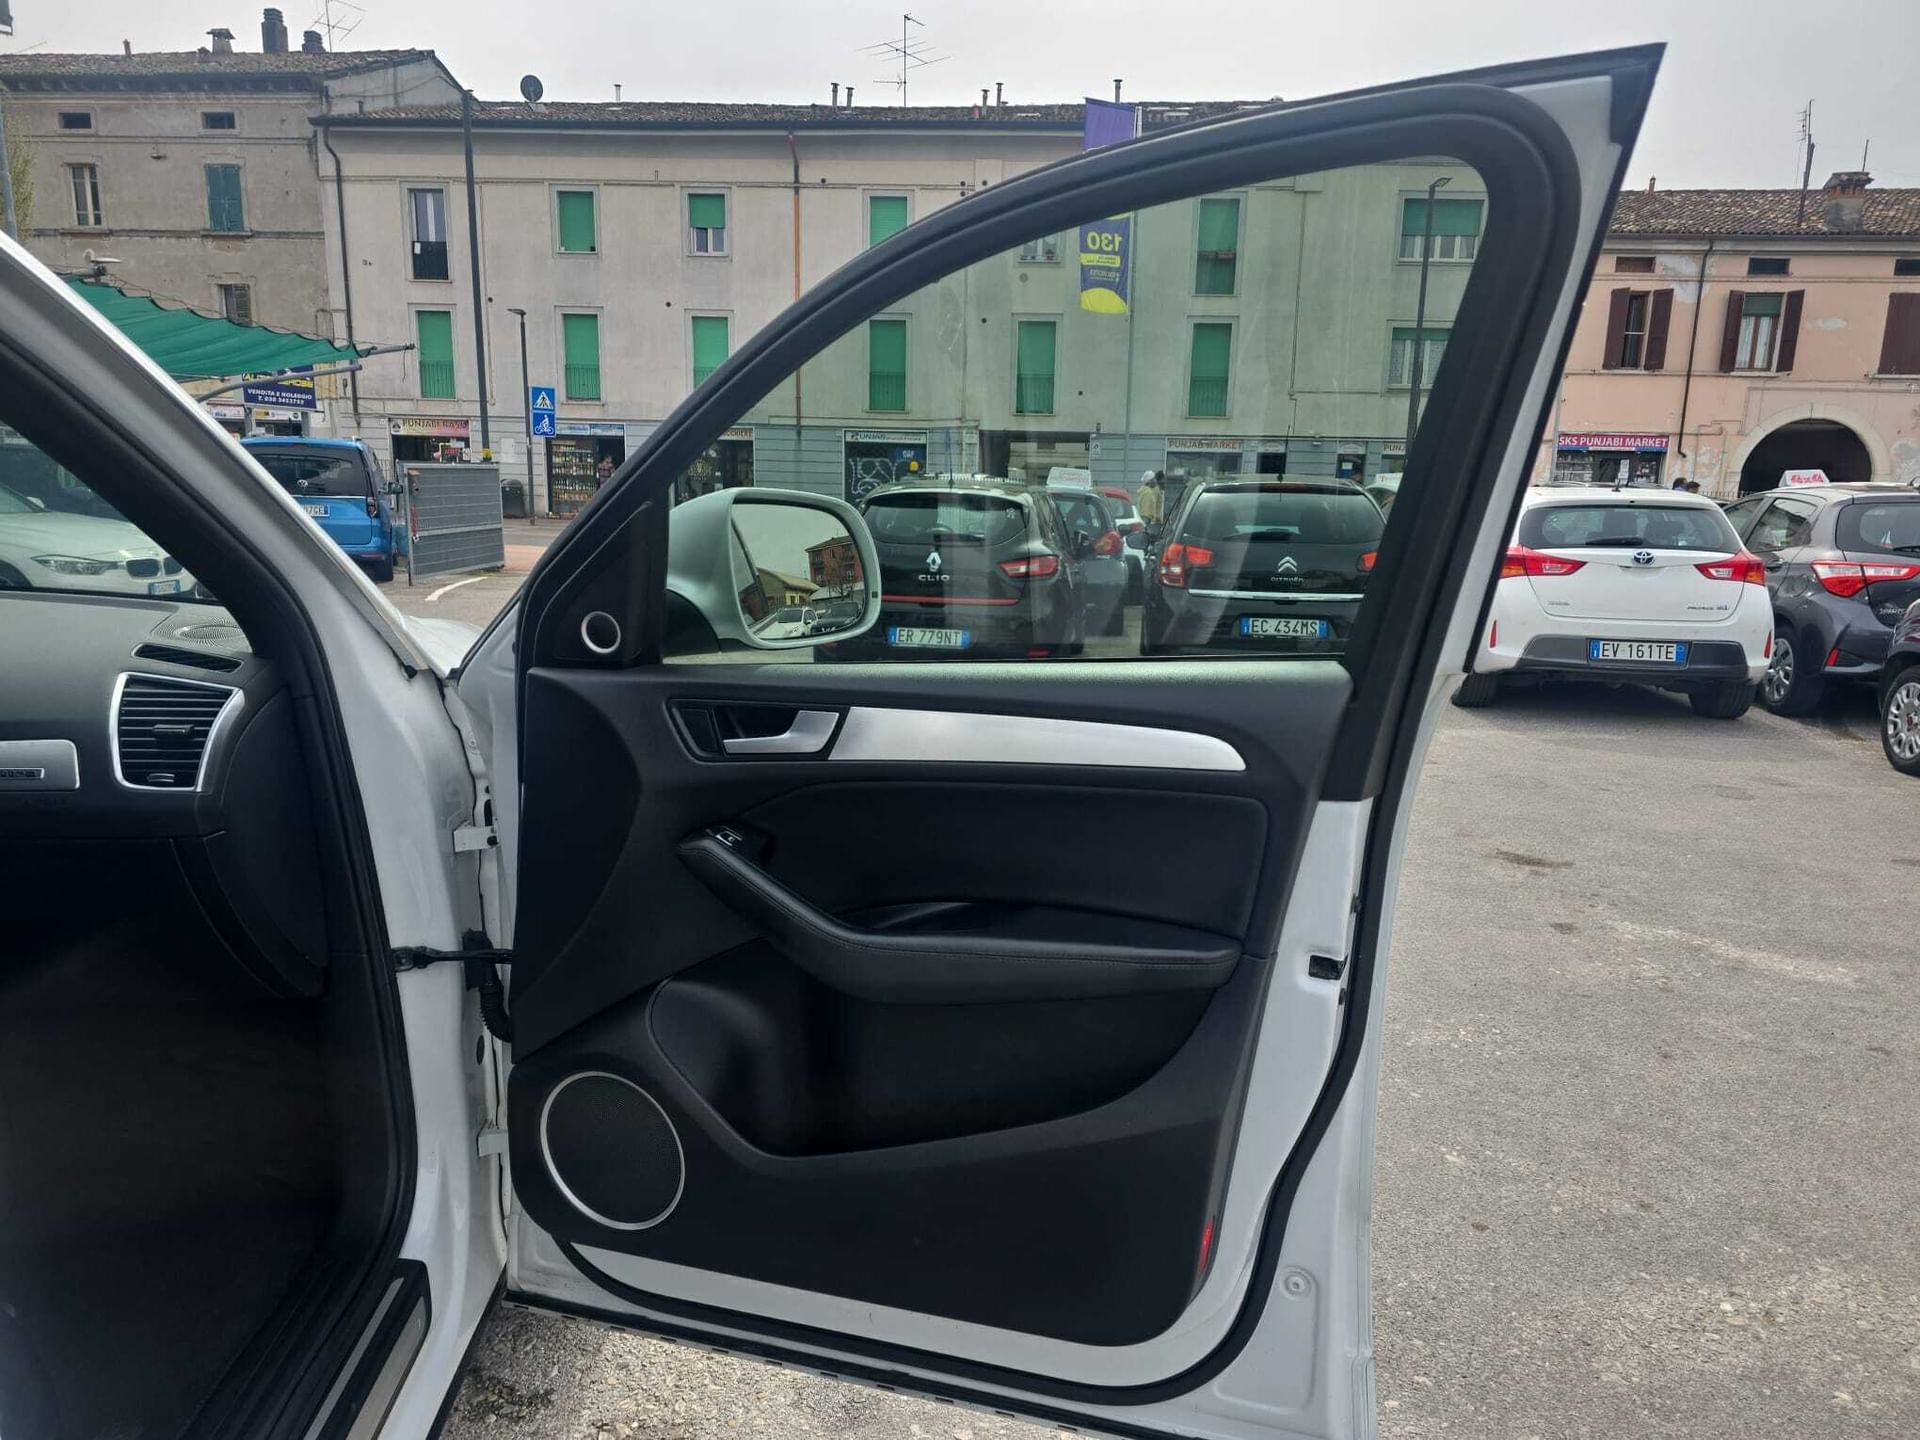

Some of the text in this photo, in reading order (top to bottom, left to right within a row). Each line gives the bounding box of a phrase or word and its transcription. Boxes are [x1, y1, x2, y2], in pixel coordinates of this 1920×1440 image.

[247, 388, 275, 397] VENDITA
[281, 391, 313, 400] NOLEGGIO
[1559, 436, 1668, 448] SKS PUNJABI MARKET
[1251, 619, 1318, 635] EC 434MS
[897, 628, 961, 645] ER 779NT
[1601, 642, 1675, 661] EV 161TE
